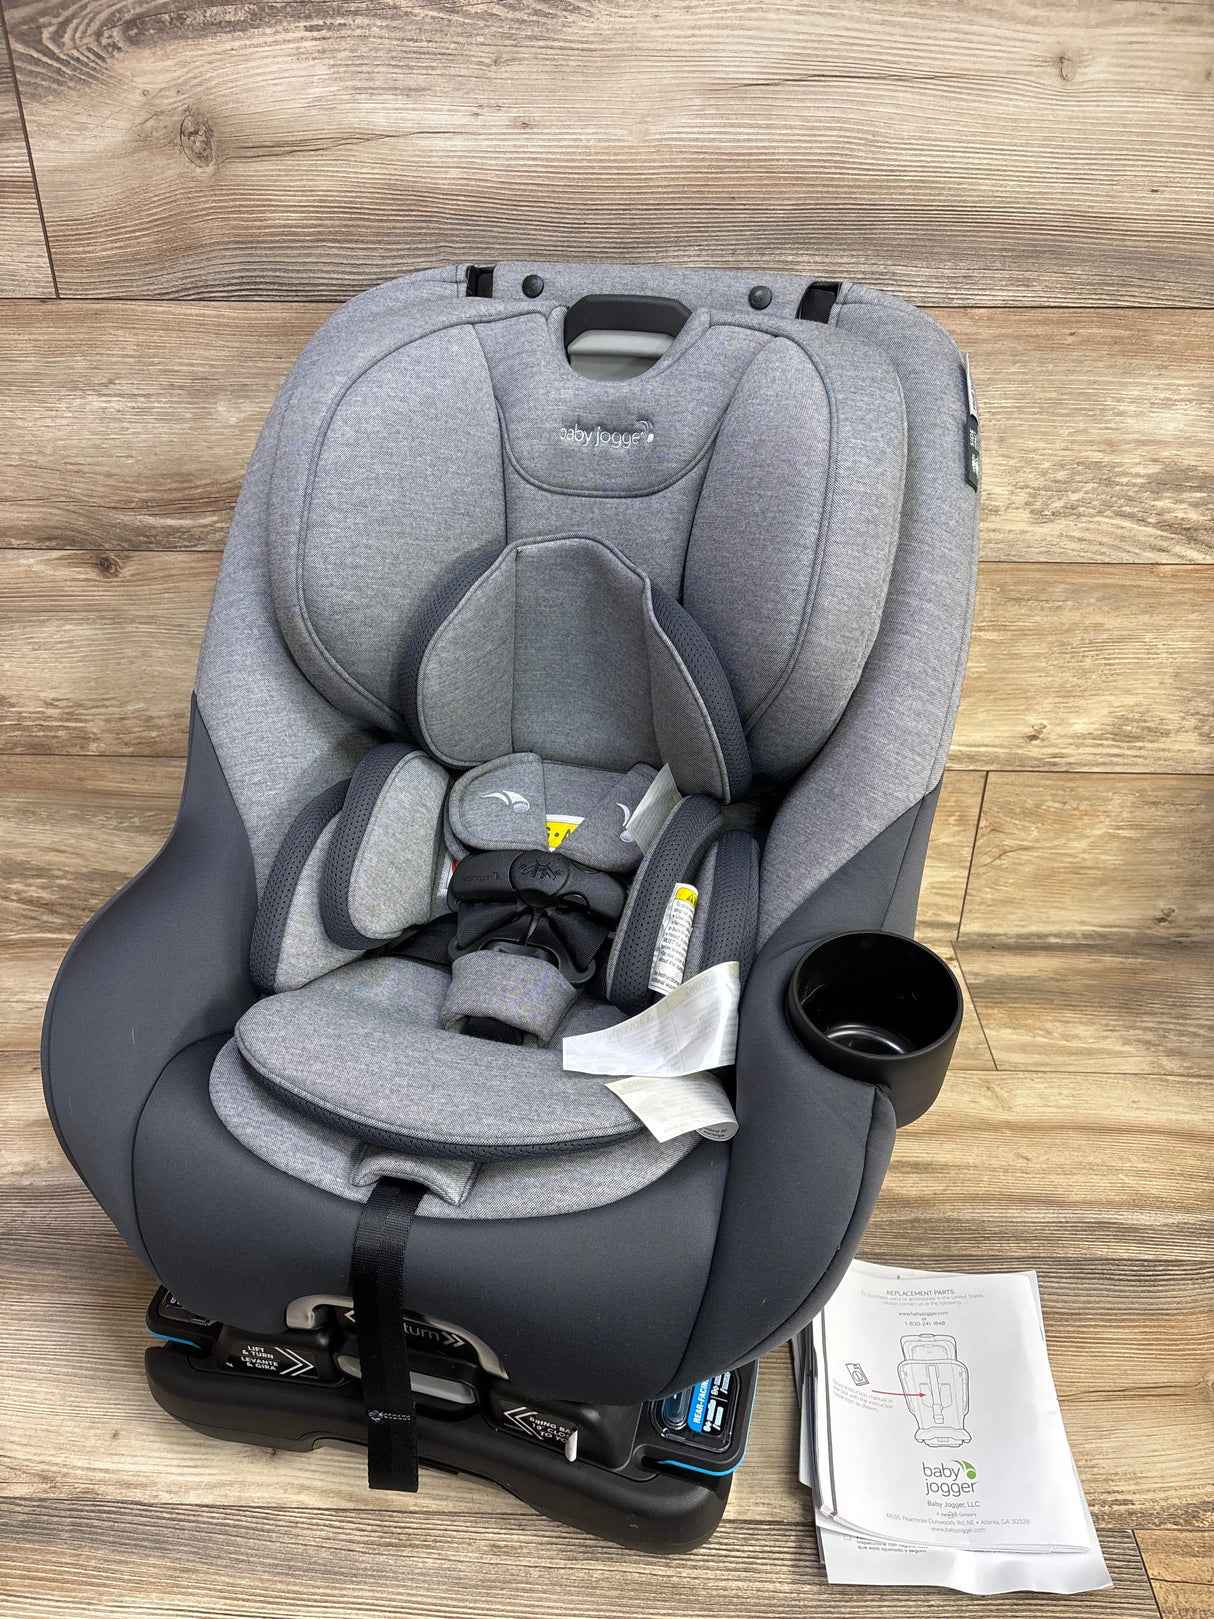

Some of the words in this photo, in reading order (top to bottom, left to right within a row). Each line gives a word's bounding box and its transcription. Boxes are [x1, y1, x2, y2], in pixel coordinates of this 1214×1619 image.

[886, 1289, 932, 1297] REPLACEMENT
[933, 1288, 956, 1296] PARTS
[402, 1322, 441, 1342] turn
[251, 1351, 273, 1359] TURN
[241, 1356, 278, 1366] LEVANTE
[692, 1379, 710, 1424] REAR-FACIN
[529, 1416, 557, 1429] BRING
[540, 1431, 553, 1439] TO
[922, 1461, 960, 1481] baby
[924, 1478, 978, 1497] jogger
[926, 1499, 943, 1509] Baby
[944, 1500, 967, 1510] Jogger,
[966, 1500, 981, 1508] LLC
[1000, 1518, 1010, 1526] GA
[930, 1526, 987, 1534] www.babyjogger.com
